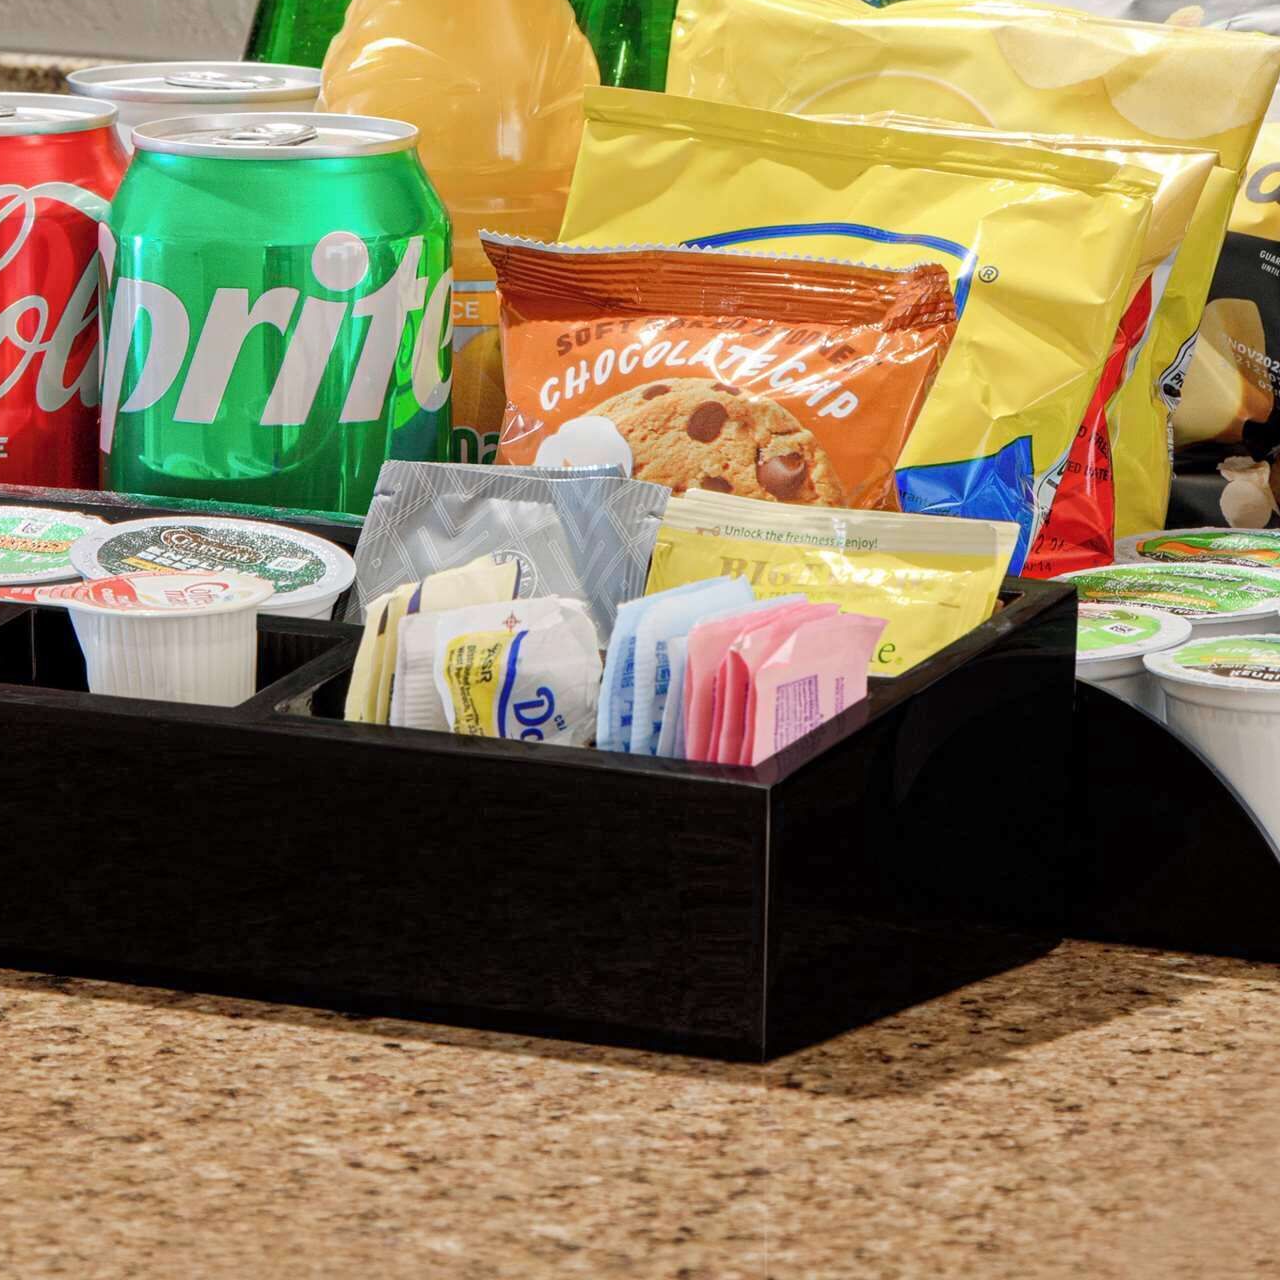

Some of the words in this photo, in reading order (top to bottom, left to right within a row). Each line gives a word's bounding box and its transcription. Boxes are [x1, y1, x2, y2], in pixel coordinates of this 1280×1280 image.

[99, 221, 453, 455] prite
[555, 320, 631, 357] SOFT
[540, 337, 778, 411] CHOCOLATE
[769, 361, 860, 418] CHIP
[725, 525, 762, 539] Unlock
[765, 530, 784, 543] the
[785, 531, 835, 548] freshness
[844, 537, 879, 552] enjoy!
